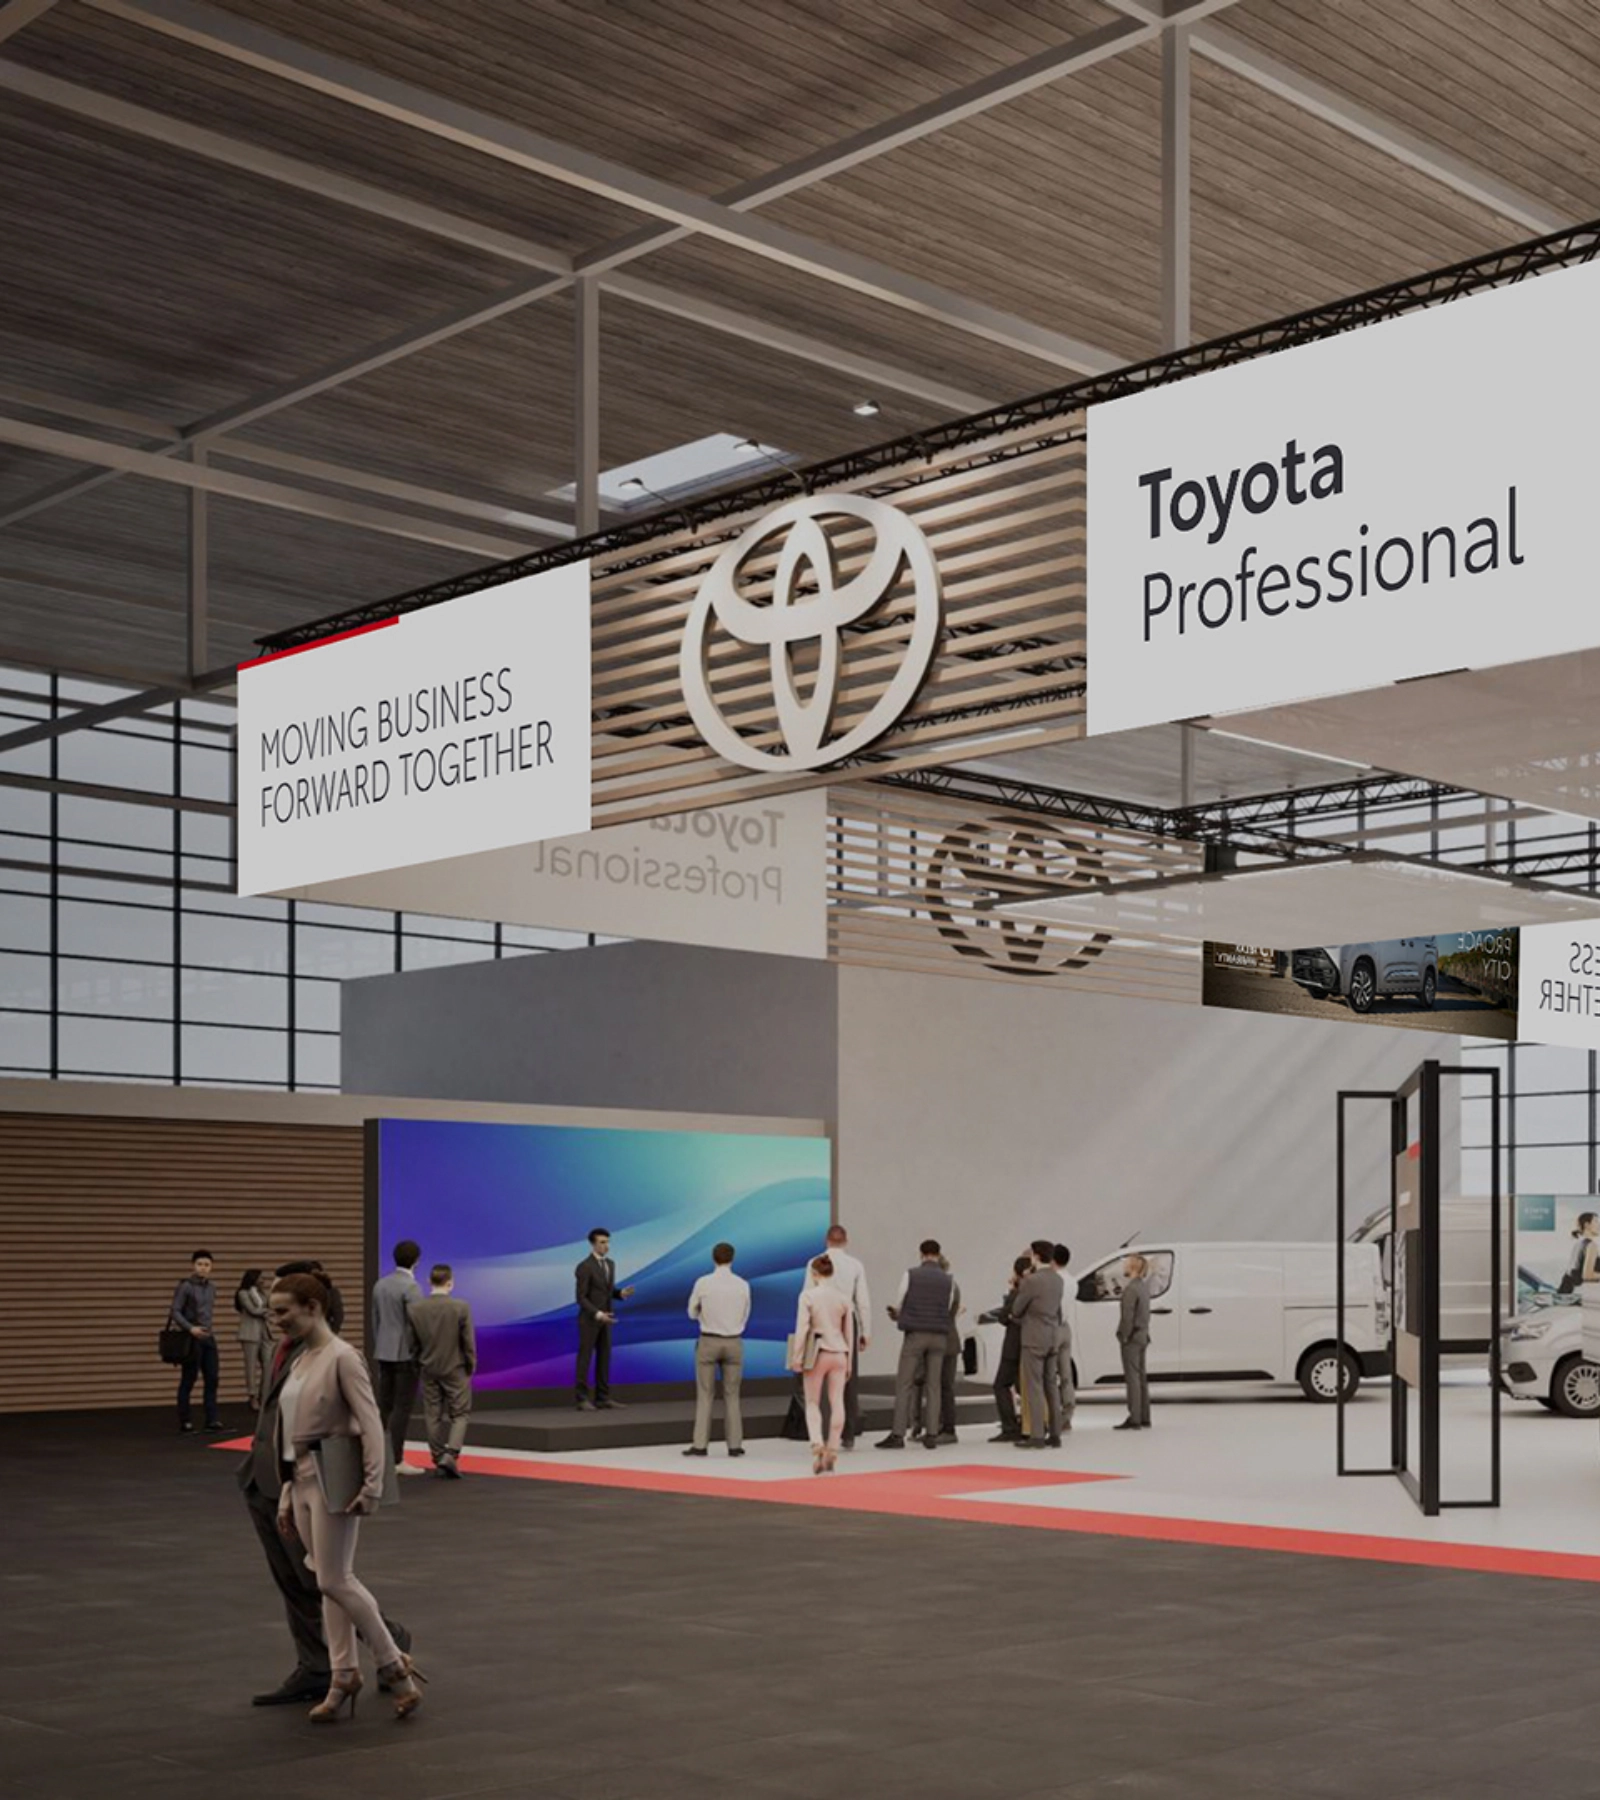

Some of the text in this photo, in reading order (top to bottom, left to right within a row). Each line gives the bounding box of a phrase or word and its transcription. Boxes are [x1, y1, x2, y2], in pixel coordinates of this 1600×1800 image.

[1138, 439, 1344, 544] Toyota
[1144, 485, 1524, 641] Professional
[261, 667, 513, 772] MOVING BUSINESS
[261, 720, 554, 827] FORWARD TOGETHER
